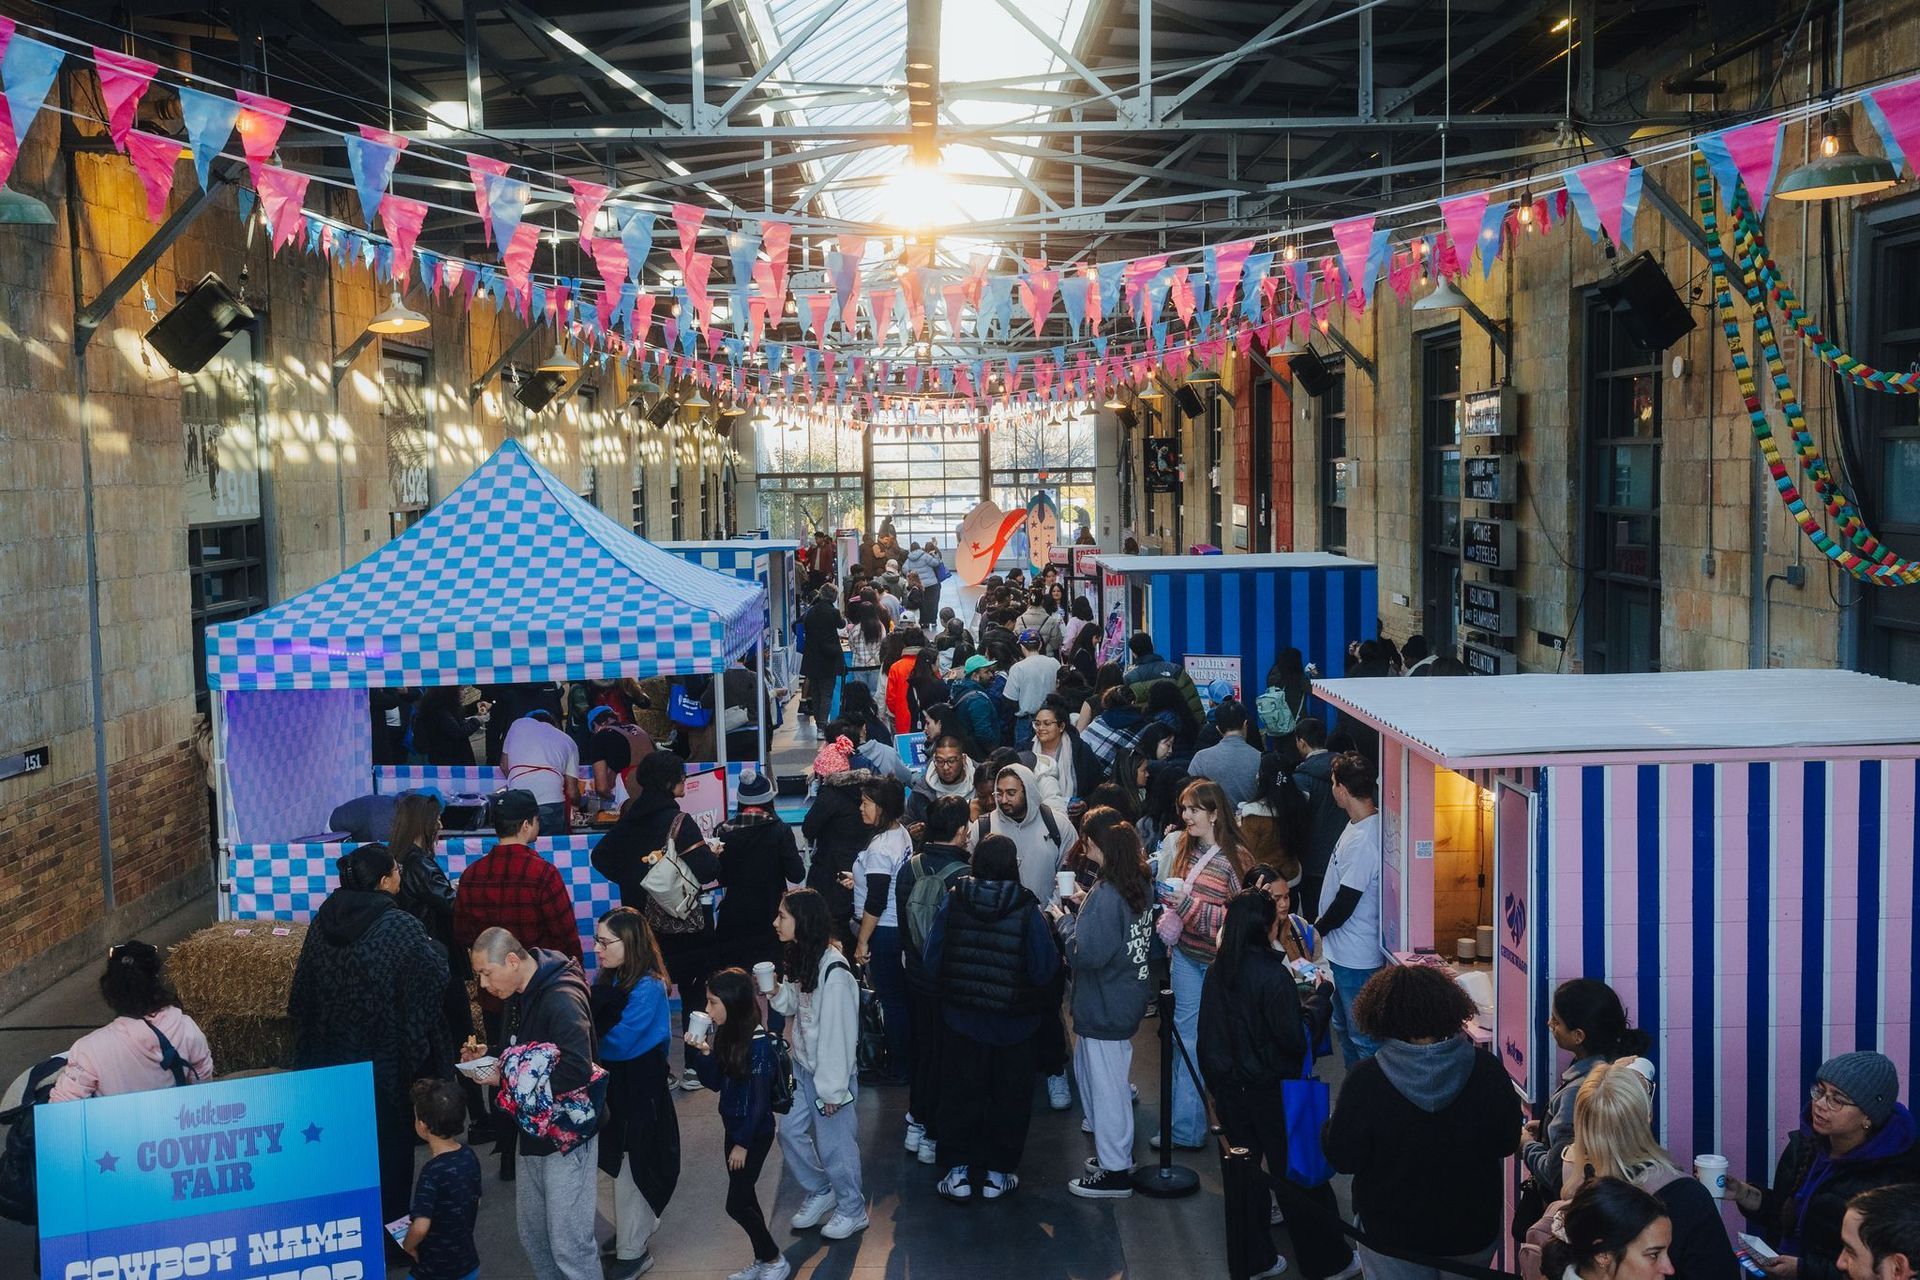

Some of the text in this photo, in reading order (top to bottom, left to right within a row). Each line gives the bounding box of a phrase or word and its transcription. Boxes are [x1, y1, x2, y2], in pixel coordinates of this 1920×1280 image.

[1472, 522, 1491, 542] YONGE
[1475, 545, 1497, 565] STEELES
[1473, 608, 1499, 632] ELMHURST
[1197, 658, 1227, 669] DAIRY
[1469, 650, 1495, 674] EGLINTON
[1188, 669, 1238, 682] FUN FACTS
[25, 753, 42, 771] 151
[137, 1122, 285, 1172] COWNTY
[171, 1161, 255, 1200] FAIR
[65, 1237, 237, 1280] COWBOY
[248, 1216, 362, 1265] NAME
